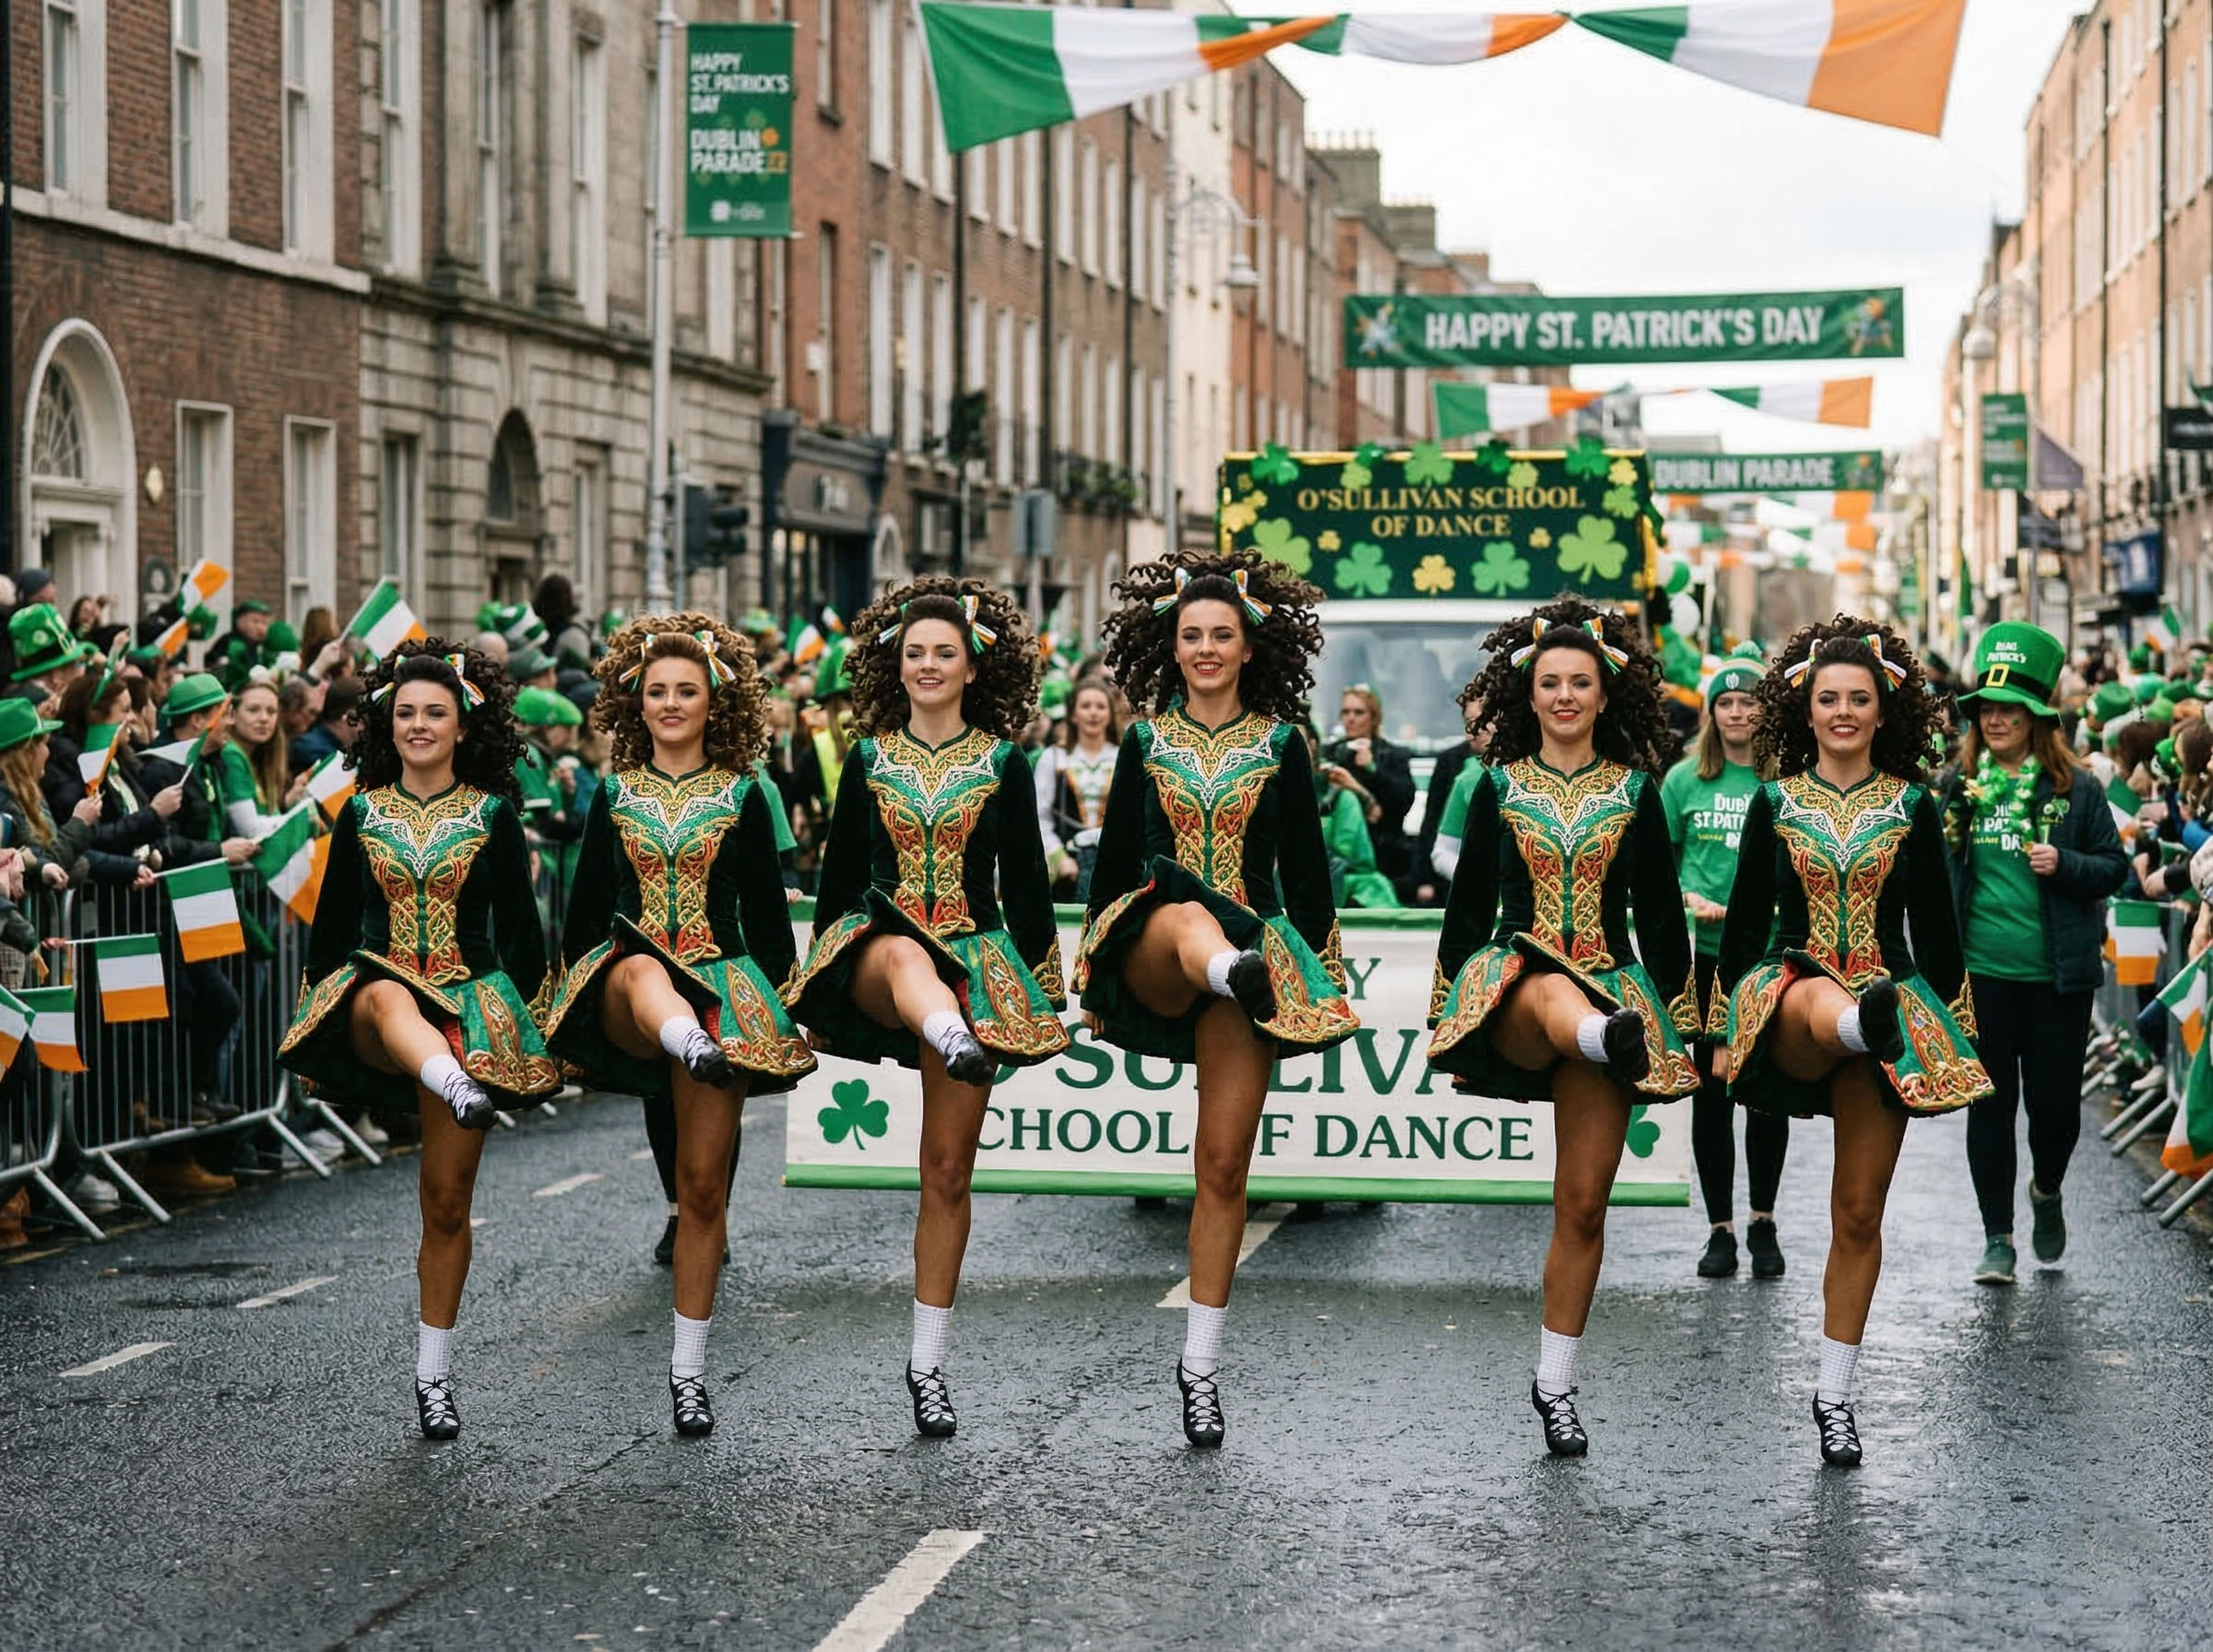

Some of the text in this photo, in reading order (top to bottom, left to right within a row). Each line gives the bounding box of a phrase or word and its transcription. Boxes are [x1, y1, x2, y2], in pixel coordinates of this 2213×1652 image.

[691, 53, 742, 72] HAPPY
[691, 95, 720, 113] DAY
[691, 129, 761, 150] DUBLIN
[691, 152, 764, 173] PARADE
[1426, 306, 1824, 349] HAPPY ST. PATRICK'S DAY
[1655, 458, 1835, 488] DUBLIN PARADE
[1296, 486, 1586, 511] O'SULLIVAN SCHOOL
[1371, 514, 1512, 537] OF DANCE
[977, 1106, 1189, 1153] CHOOL
[1314, 1115, 1534, 1161] DANCE
